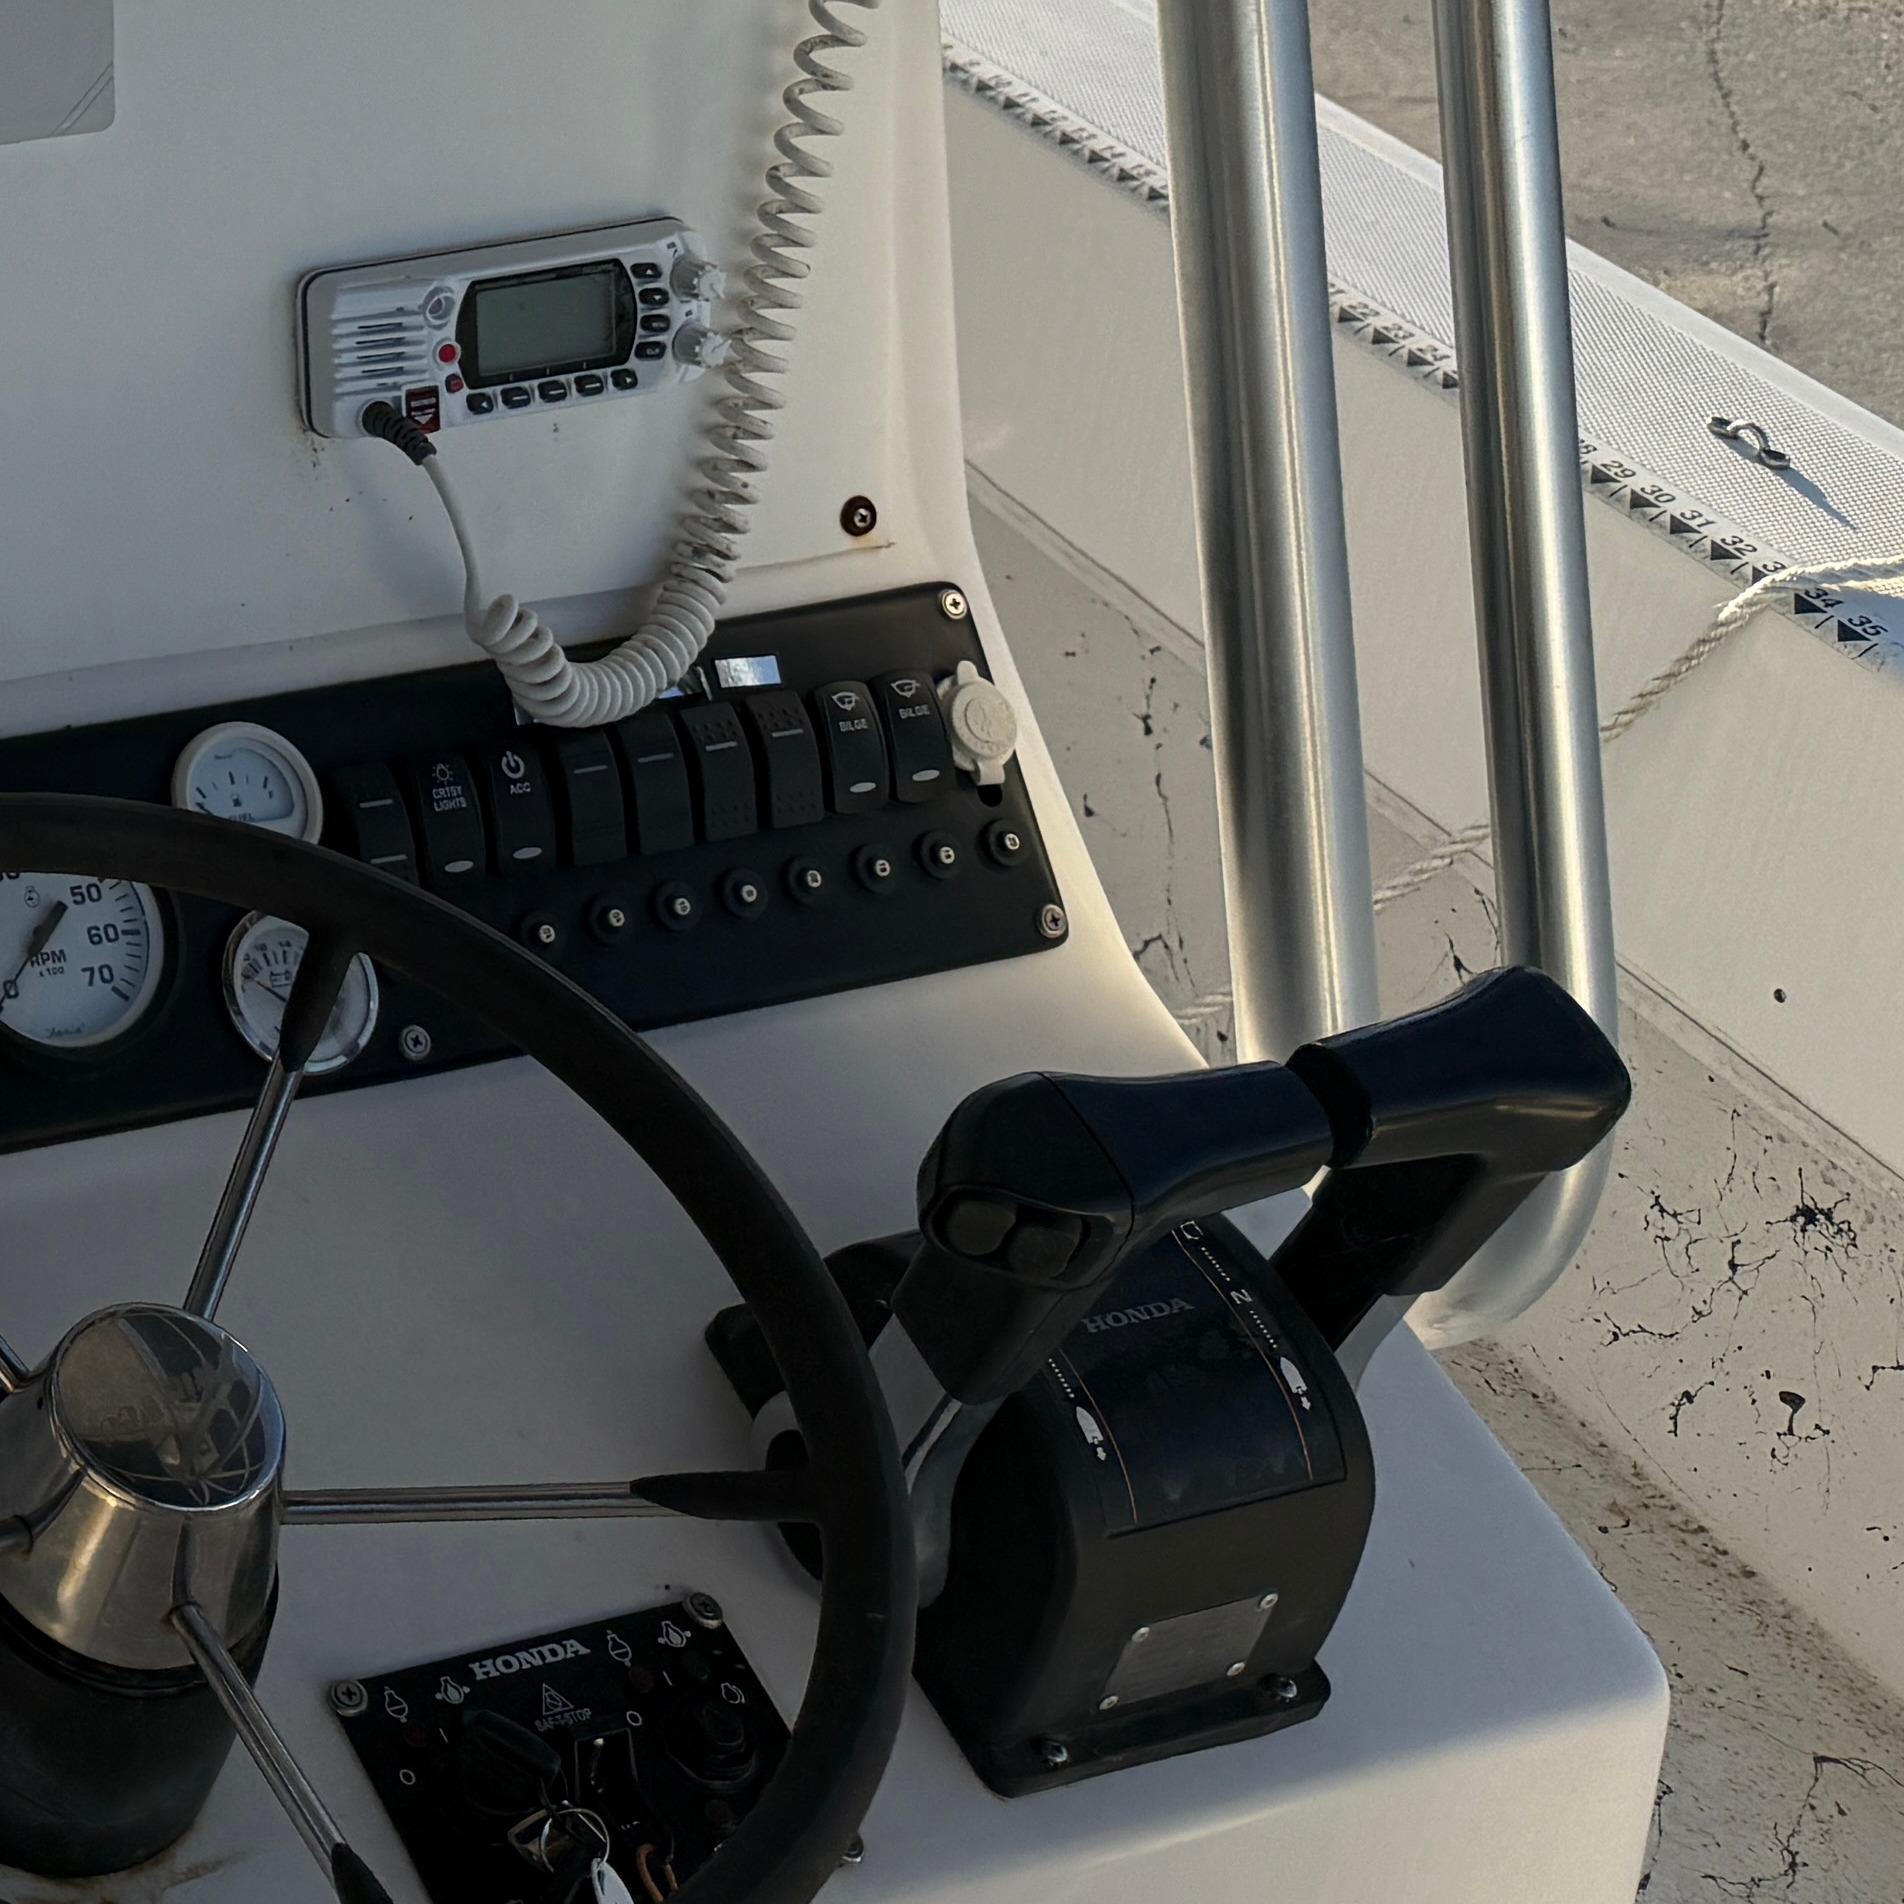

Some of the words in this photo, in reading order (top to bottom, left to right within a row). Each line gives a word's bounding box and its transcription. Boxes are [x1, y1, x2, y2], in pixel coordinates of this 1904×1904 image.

[1600, 459, 1636, 479] 29
[1640, 484, 1676, 504] 30
[1680, 509, 1716, 528] 31
[1721, 535, 1758, 557] 32
[1762, 560, 1787, 573] 3
[1804, 588, 1845, 609] 34
[1848, 614, 1889, 637] 35
[898, 704, 931, 719] BILGE
[838, 717, 870, 733] BILGE
[510, 782, 532, 795] ACC
[433, 796, 468, 812] LIGHTS
[70, 882, 101, 906] 50
[87, 923, 119, 946] 60
[30, 949, 67, 968] RPM
[81, 963, 114, 987] 70
[2, 978, 20, 1000] 0
[1080, 1297, 1196, 1334] HONDA
[468, 1638, 591, 1681] HONDA
